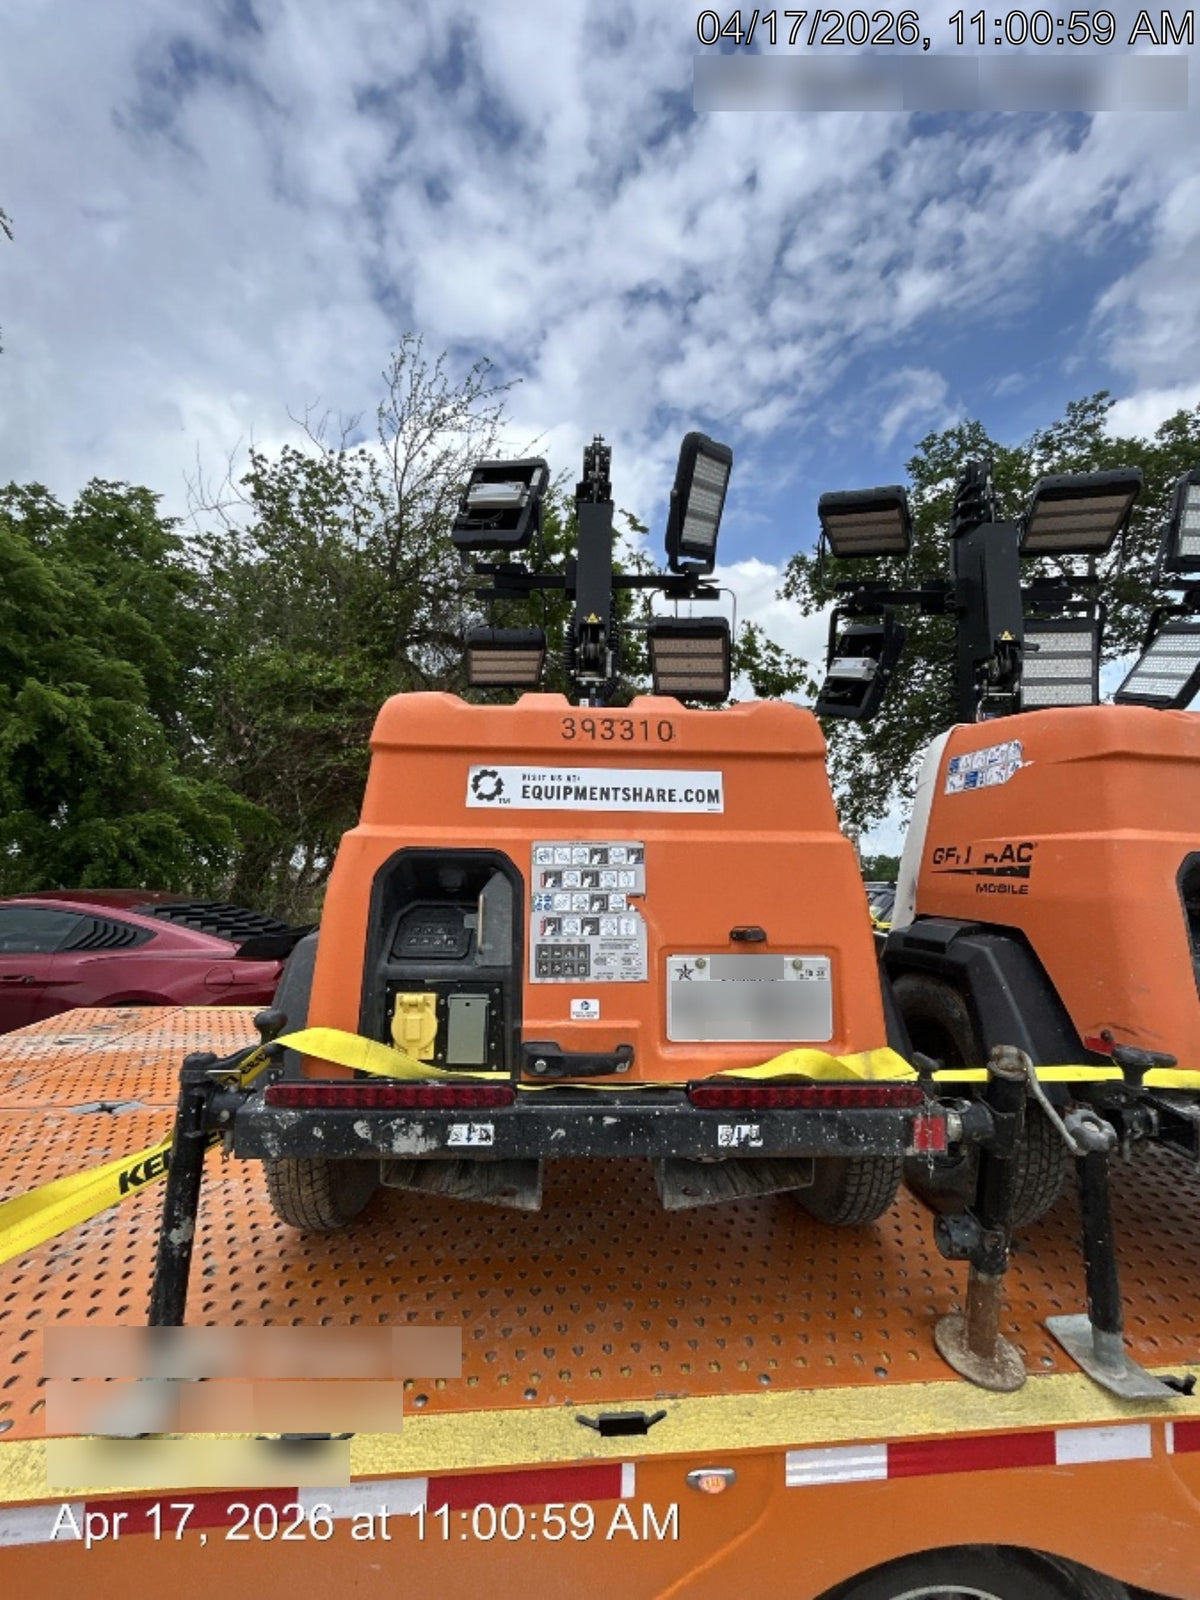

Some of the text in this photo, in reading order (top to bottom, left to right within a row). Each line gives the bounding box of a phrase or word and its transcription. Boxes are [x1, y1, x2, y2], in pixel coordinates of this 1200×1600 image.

[561, 718, 674, 742] 393310
[521, 784, 720, 804] EQUIPMENTSHARE.COM
[933, 842, 1033, 865] GERAC
[975, 883, 1029, 895] MOBILE
